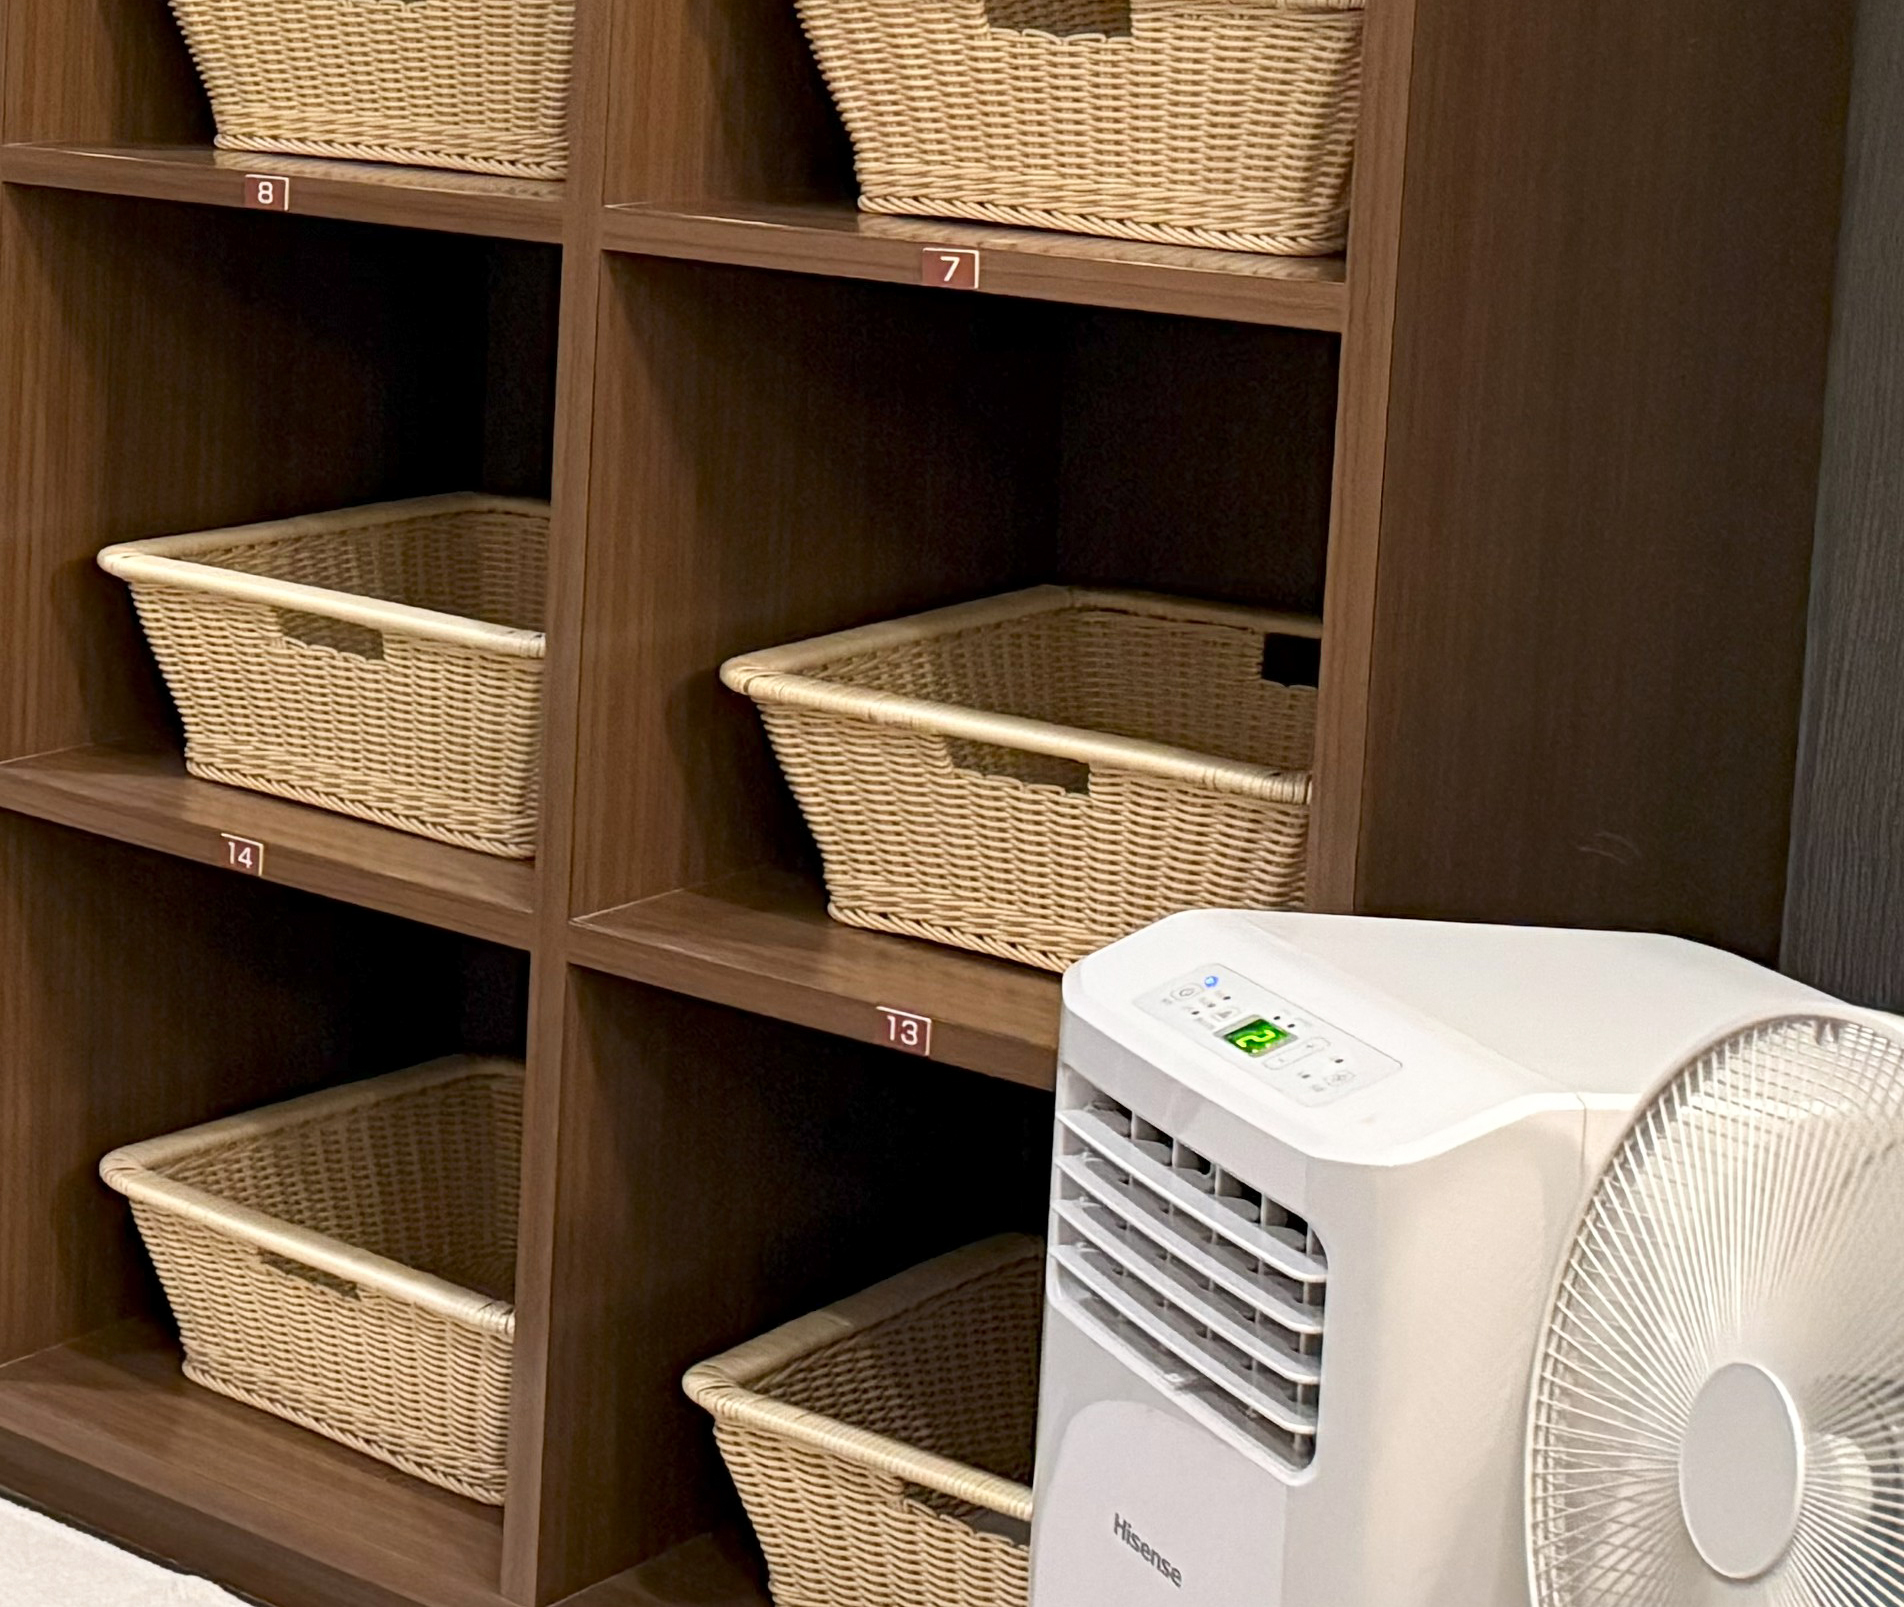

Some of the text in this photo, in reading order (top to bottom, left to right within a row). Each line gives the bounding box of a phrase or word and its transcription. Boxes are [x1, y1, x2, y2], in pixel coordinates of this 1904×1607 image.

[258, 181, 273, 204] 8
[940, 256, 960, 282] 7
[228, 842, 253, 868] 14
[888, 1015, 918, 1045] 13
[1114, 1512, 1182, 1588] Hisense
